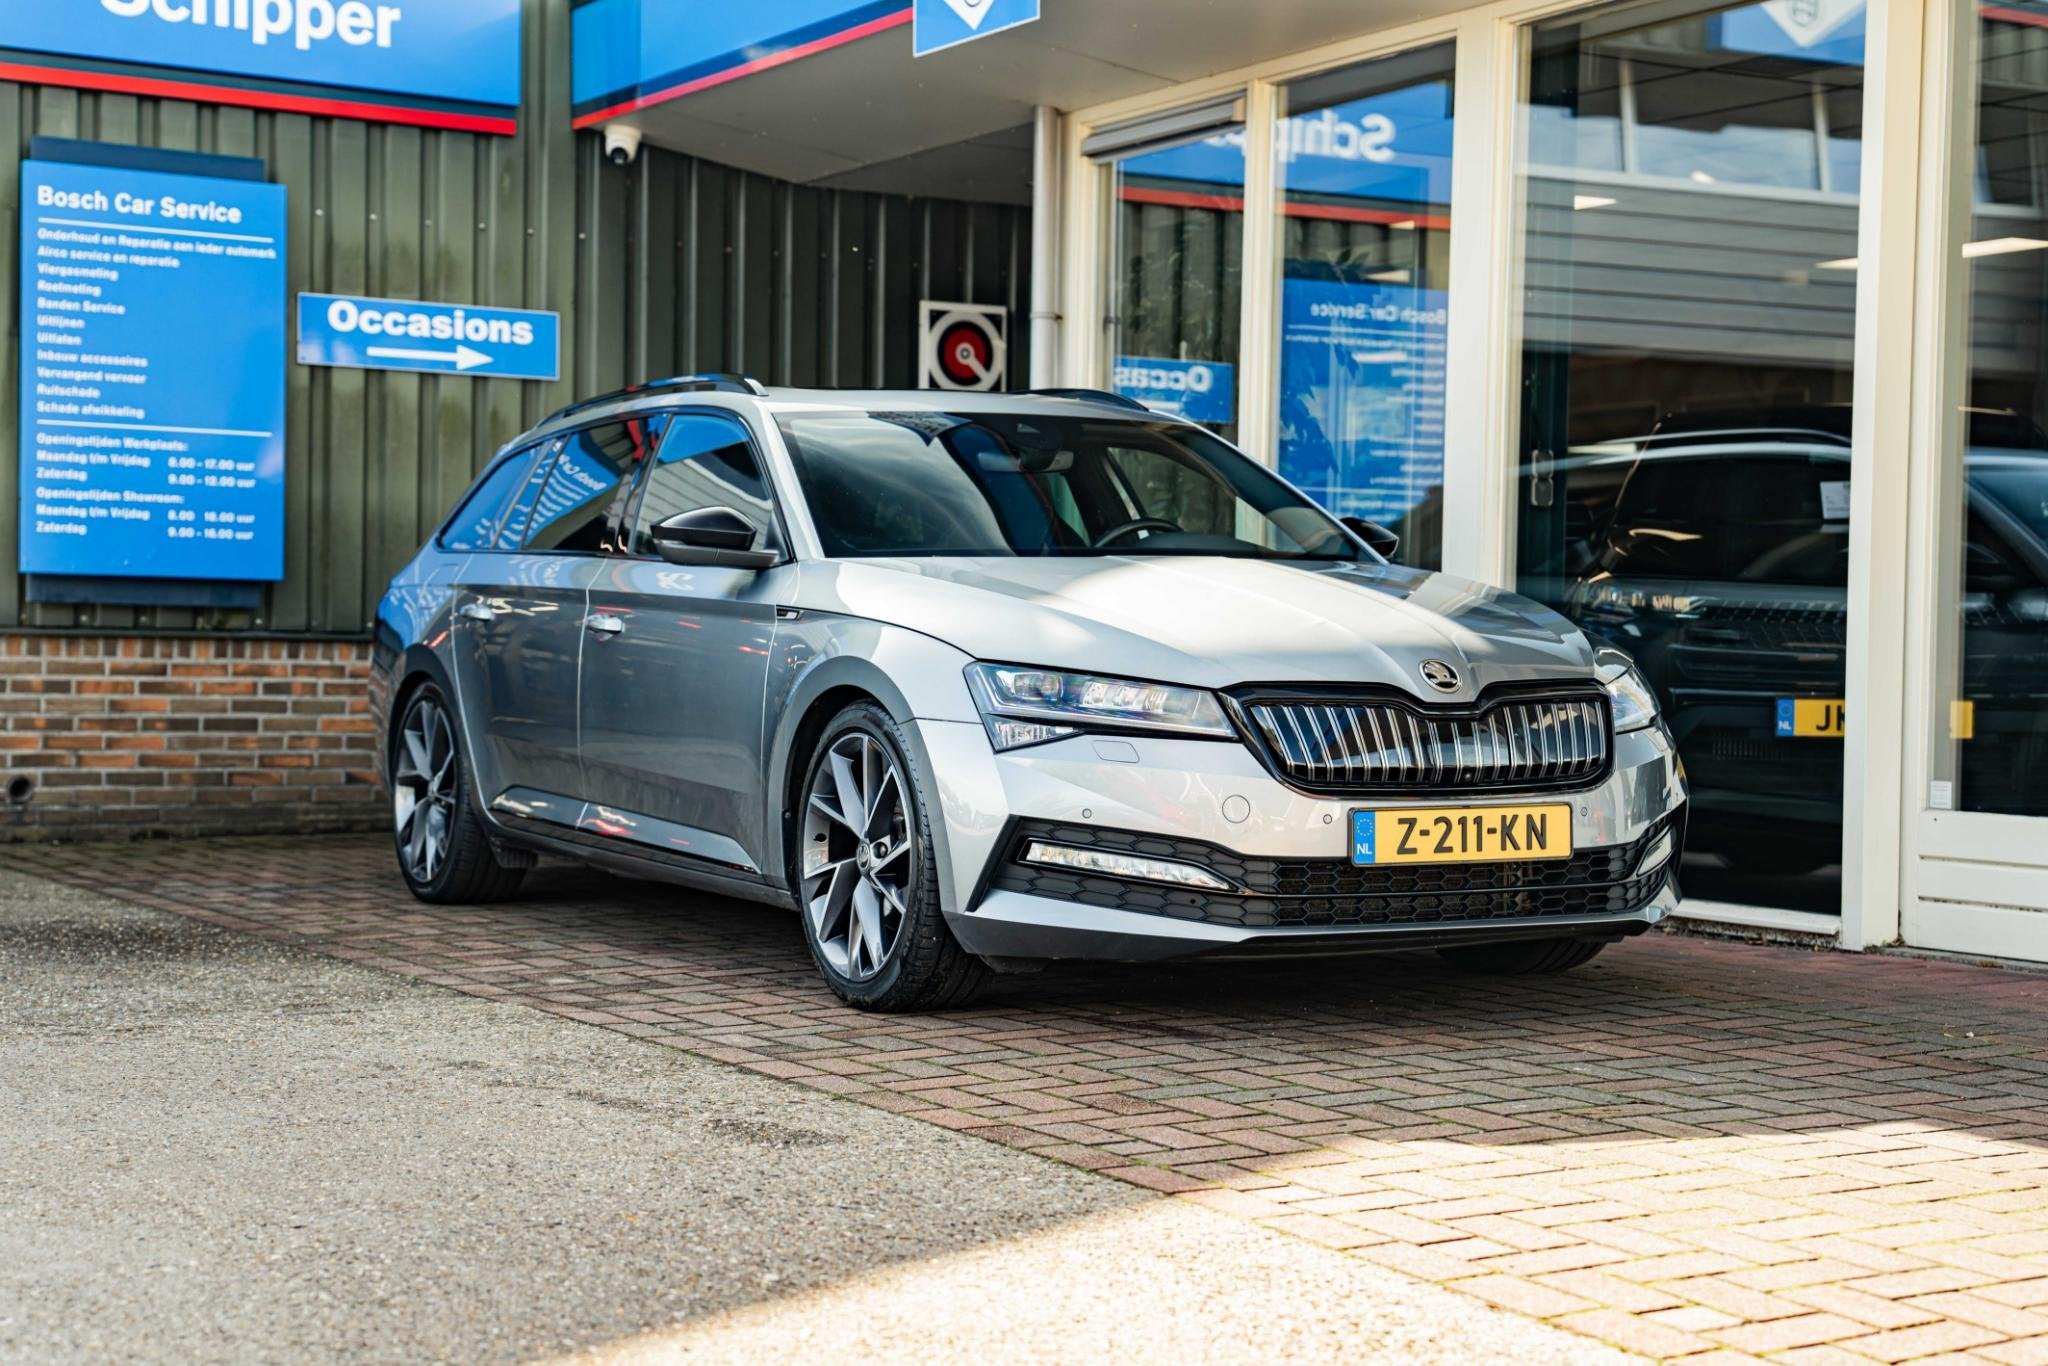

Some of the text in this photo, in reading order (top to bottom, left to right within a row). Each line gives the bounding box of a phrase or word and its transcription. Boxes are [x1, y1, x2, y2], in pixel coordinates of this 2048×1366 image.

[37, 185, 242, 224] Bosch Car Service
[37, 227, 100, 244] Onderhoud
[101, 235, 116, 245] en
[118, 234, 171, 250] Reparatie
[37, 245, 180, 269] Airco service en reparatie
[37, 297, 126, 315] Banden Service
[37, 314, 86, 329] Uitlijnen
[327, 300, 534, 345] Occasions
[37, 331, 82, 346] Uitlaten
[37, 348, 149, 368] Inbouw accessoires
[37, 366, 147, 384] Vervangend vervoer
[37, 383, 101, 399] Ruitschade
[37, 400, 145, 420] Schade afwikkeling
[36, 432, 122, 448] Openingstijden
[36, 450, 88, 465] Maandag
[110, 454, 151, 468] Vrijdag
[236, 462, 256, 472] uur
[36, 466, 88, 482] Zaterdag
[236, 479, 256, 489] uur
[36, 486, 122, 502] Openingstijden
[36, 504, 88, 519] Maandag
[110, 507, 151, 521] Vrijdag
[236, 514, 256, 525] uur
[36, 520, 88, 536] Zaterdag
[235, 531, 254, 541] uur
[1778, 720, 1793, 731] NL
[1357, 813, 1547, 856] NL Z-211-KN
